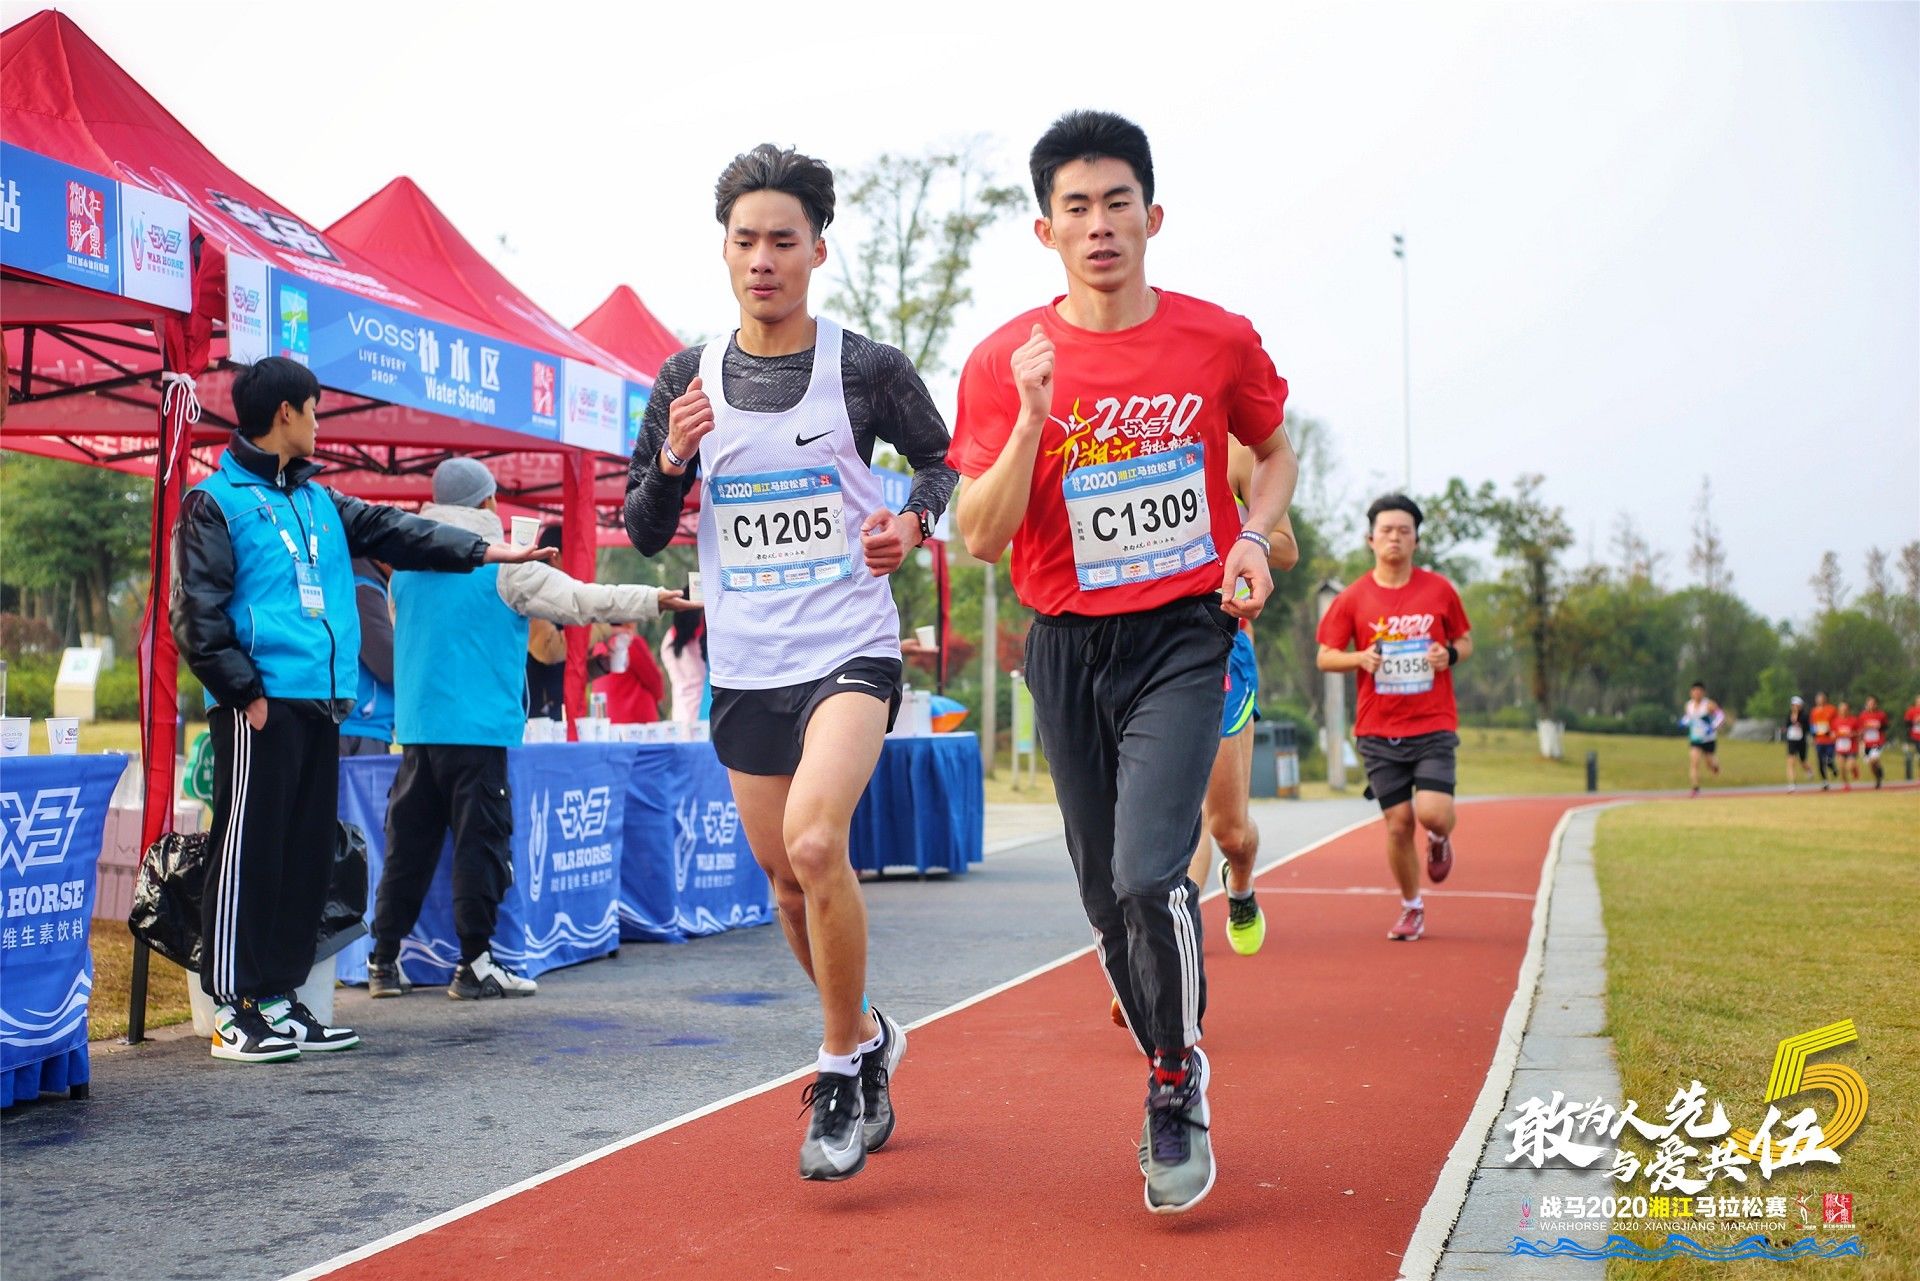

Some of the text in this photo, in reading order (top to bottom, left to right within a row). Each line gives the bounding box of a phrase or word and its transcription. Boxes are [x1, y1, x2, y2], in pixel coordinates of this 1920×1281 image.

[347, 311, 416, 352] VOSS
[358, 349, 407, 372] LIVE EVERY
[418, 327, 500, 391] 补水区
[425, 376, 457, 407] Water
[458, 384, 496, 416] Station
[734, 506, 832, 548] C1205
[1092, 488, 1199, 542] C1309
[1382, 656, 1429, 675] C1358
[7, 879, 85, 918] HORSE
[2, 917, 84, 950] 维生素饮料
